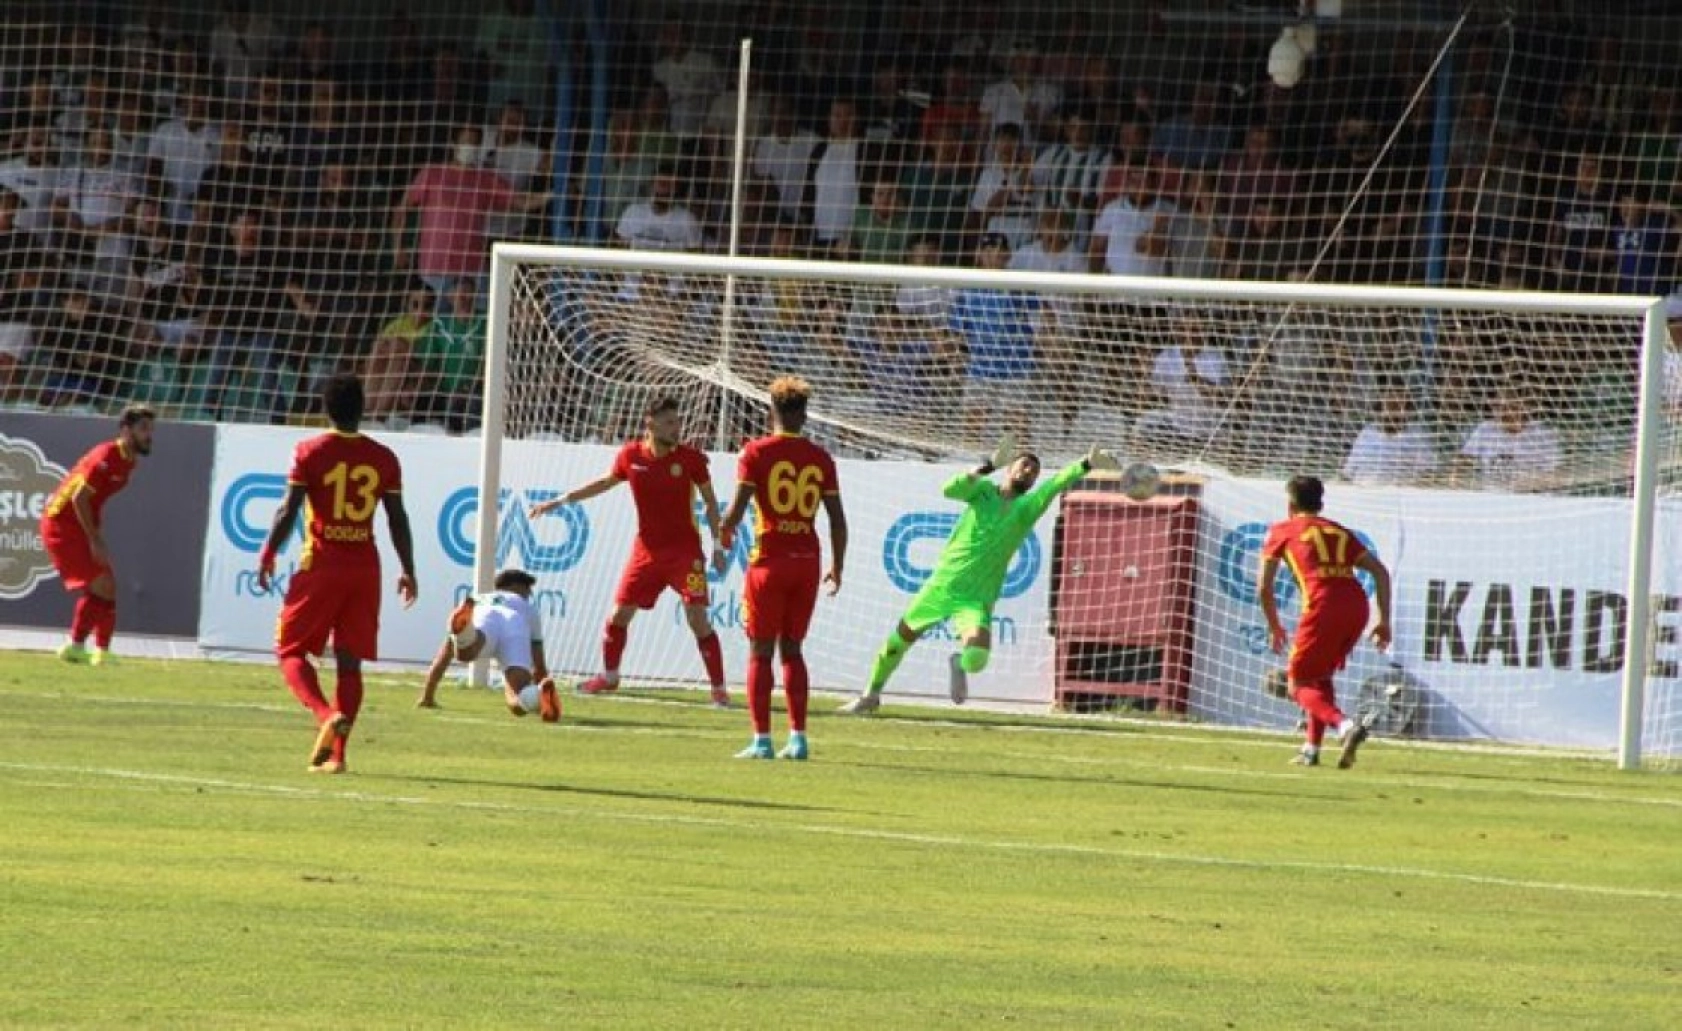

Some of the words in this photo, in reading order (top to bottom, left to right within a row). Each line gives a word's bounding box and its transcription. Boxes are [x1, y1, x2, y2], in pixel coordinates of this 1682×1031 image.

[323, 461, 378, 521] 13
[768, 460, 823, 518] 66
[1299, 525, 1347, 563] 17
